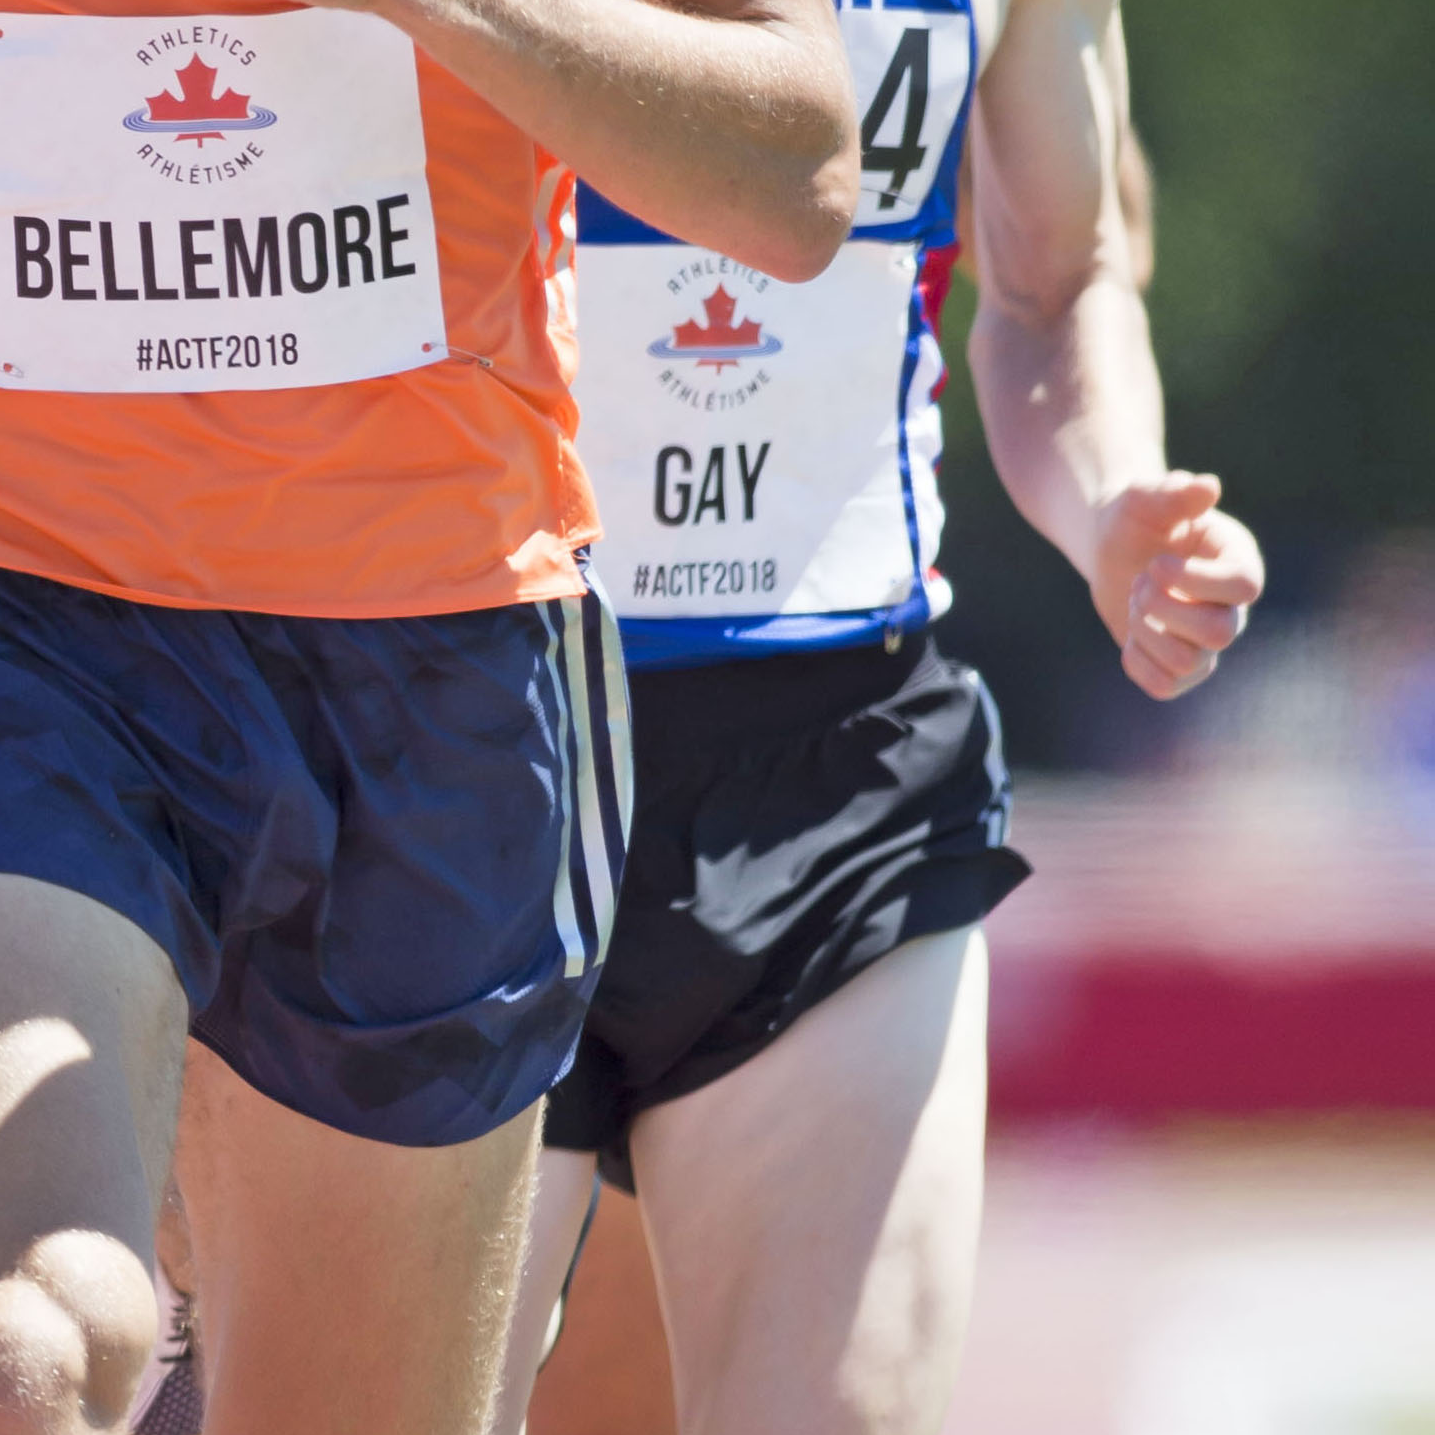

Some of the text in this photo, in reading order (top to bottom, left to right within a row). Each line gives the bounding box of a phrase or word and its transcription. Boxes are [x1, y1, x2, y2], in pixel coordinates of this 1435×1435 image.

[136, 26, 256, 66] ATHLETICS
[860, 28, 931, 210] 4
[136, 141, 264, 184] ATHLÉTISME
[14, 193, 417, 301] BELLEMORE
[136, 332, 299, 371] #ACTF2018
[653, 442, 771, 528] GAY
[632, 559, 778, 599] #ACTF2018
